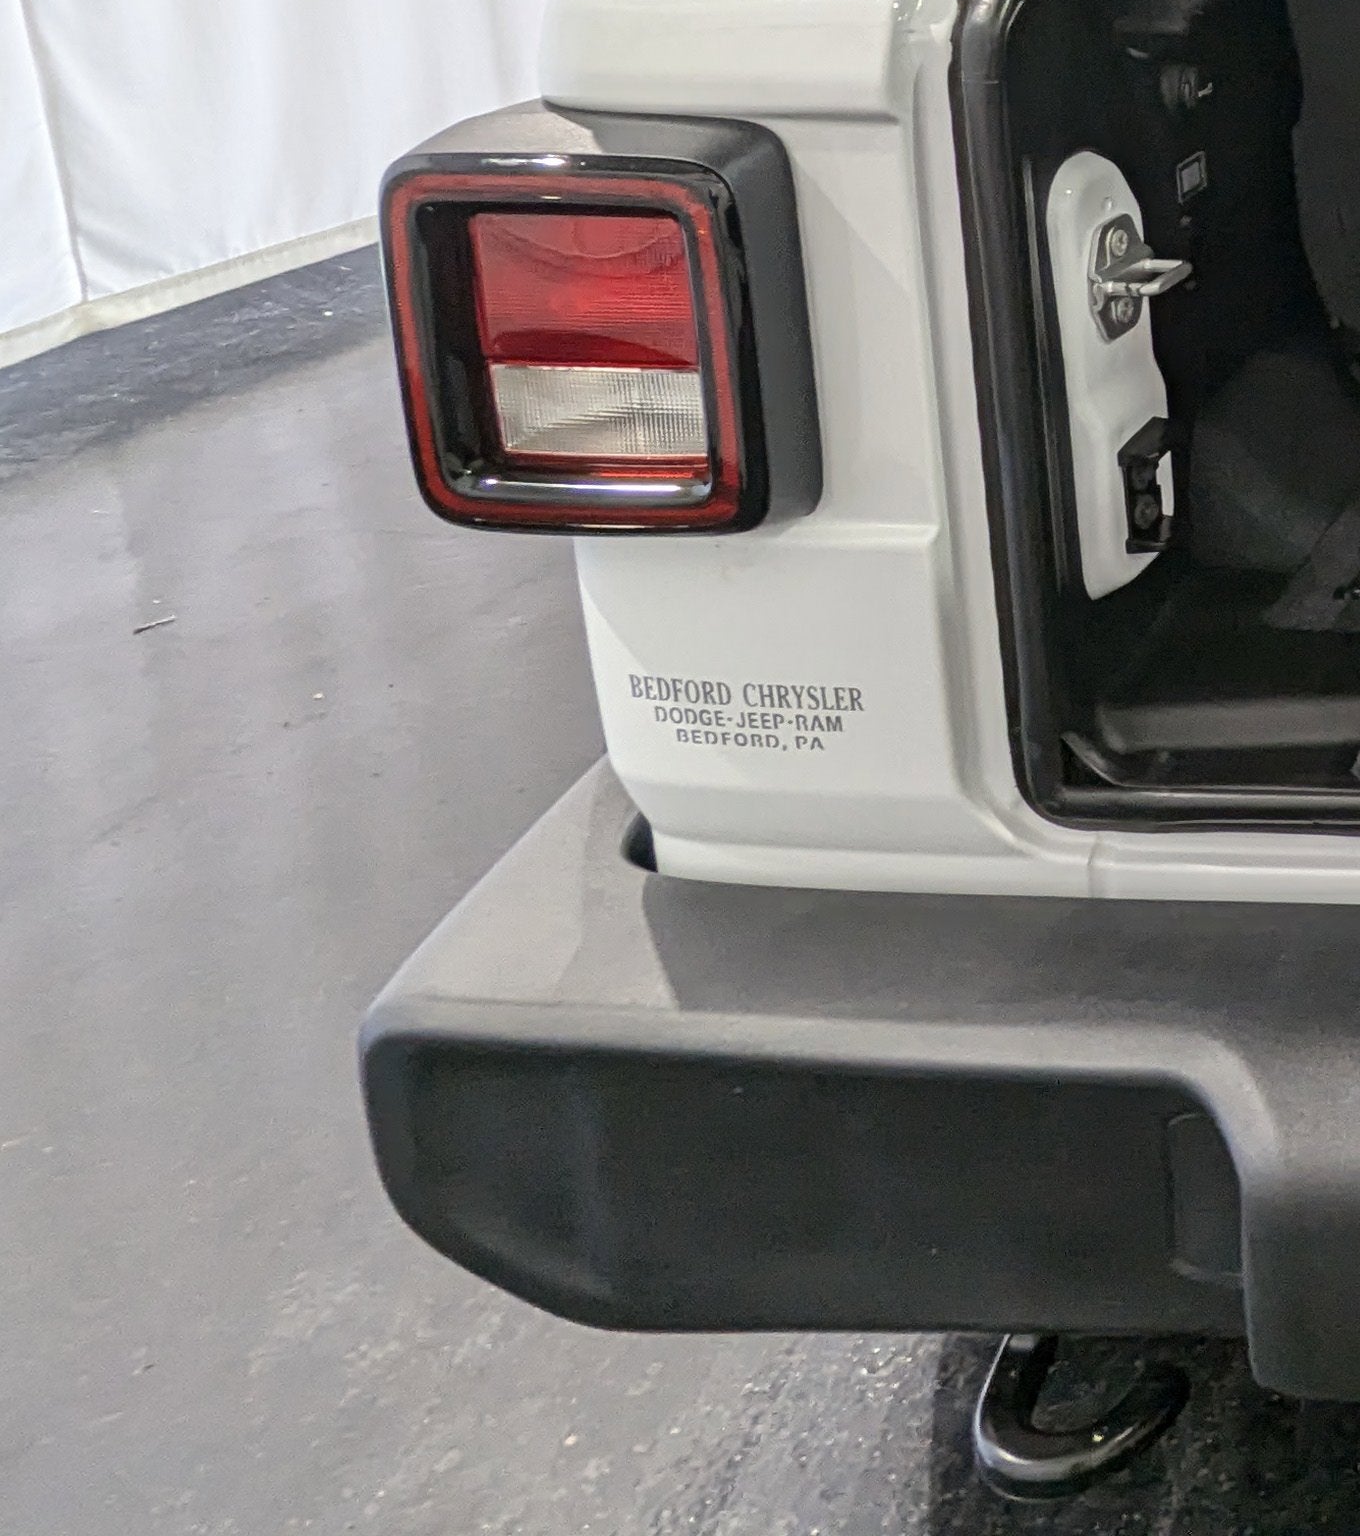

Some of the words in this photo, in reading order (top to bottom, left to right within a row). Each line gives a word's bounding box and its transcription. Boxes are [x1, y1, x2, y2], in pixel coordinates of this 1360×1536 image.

[628, 674, 732, 706] BEDFORD
[743, 682, 865, 712] CHRYSLER
[675, 728, 788, 752] BEDFORD,
[795, 735, 825, 751] PA
